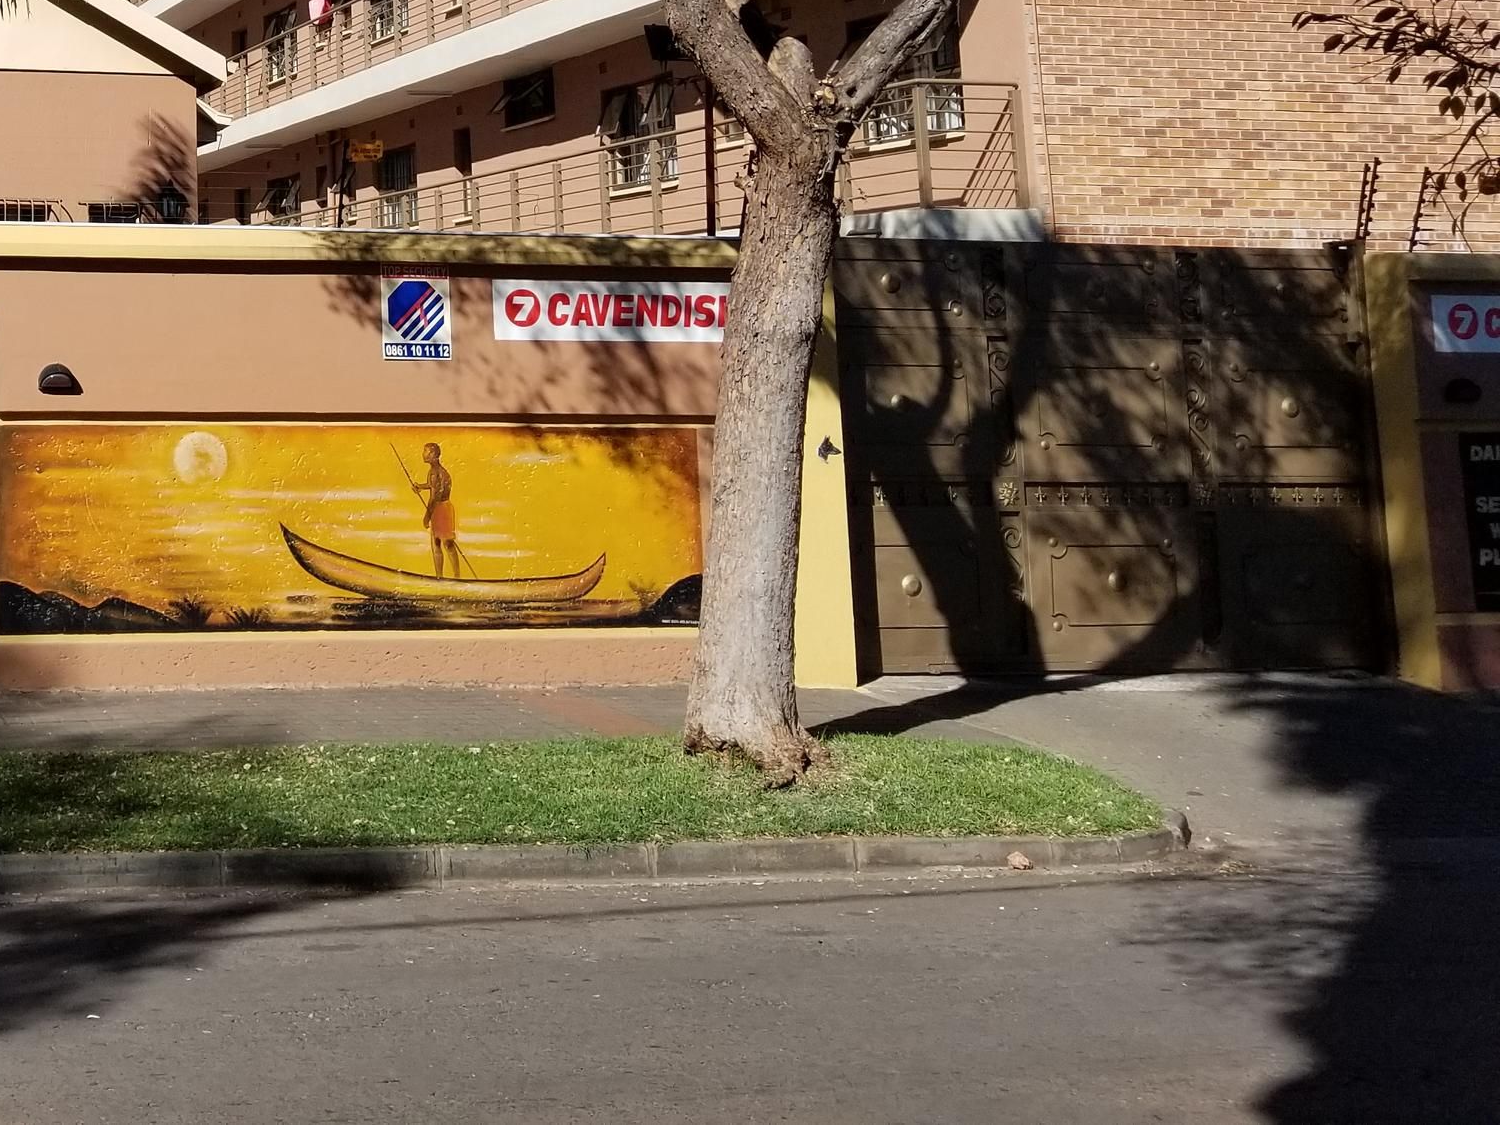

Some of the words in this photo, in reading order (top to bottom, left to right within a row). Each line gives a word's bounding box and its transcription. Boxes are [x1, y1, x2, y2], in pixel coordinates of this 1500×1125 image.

[383, 265, 401, 277] TOP
[403, 266, 446, 278] SECURITY
[386, 344, 408, 356] 0861
[410, 345, 422, 356] 10
[424, 345, 435, 356] 11
[438, 345, 449, 357] 12
